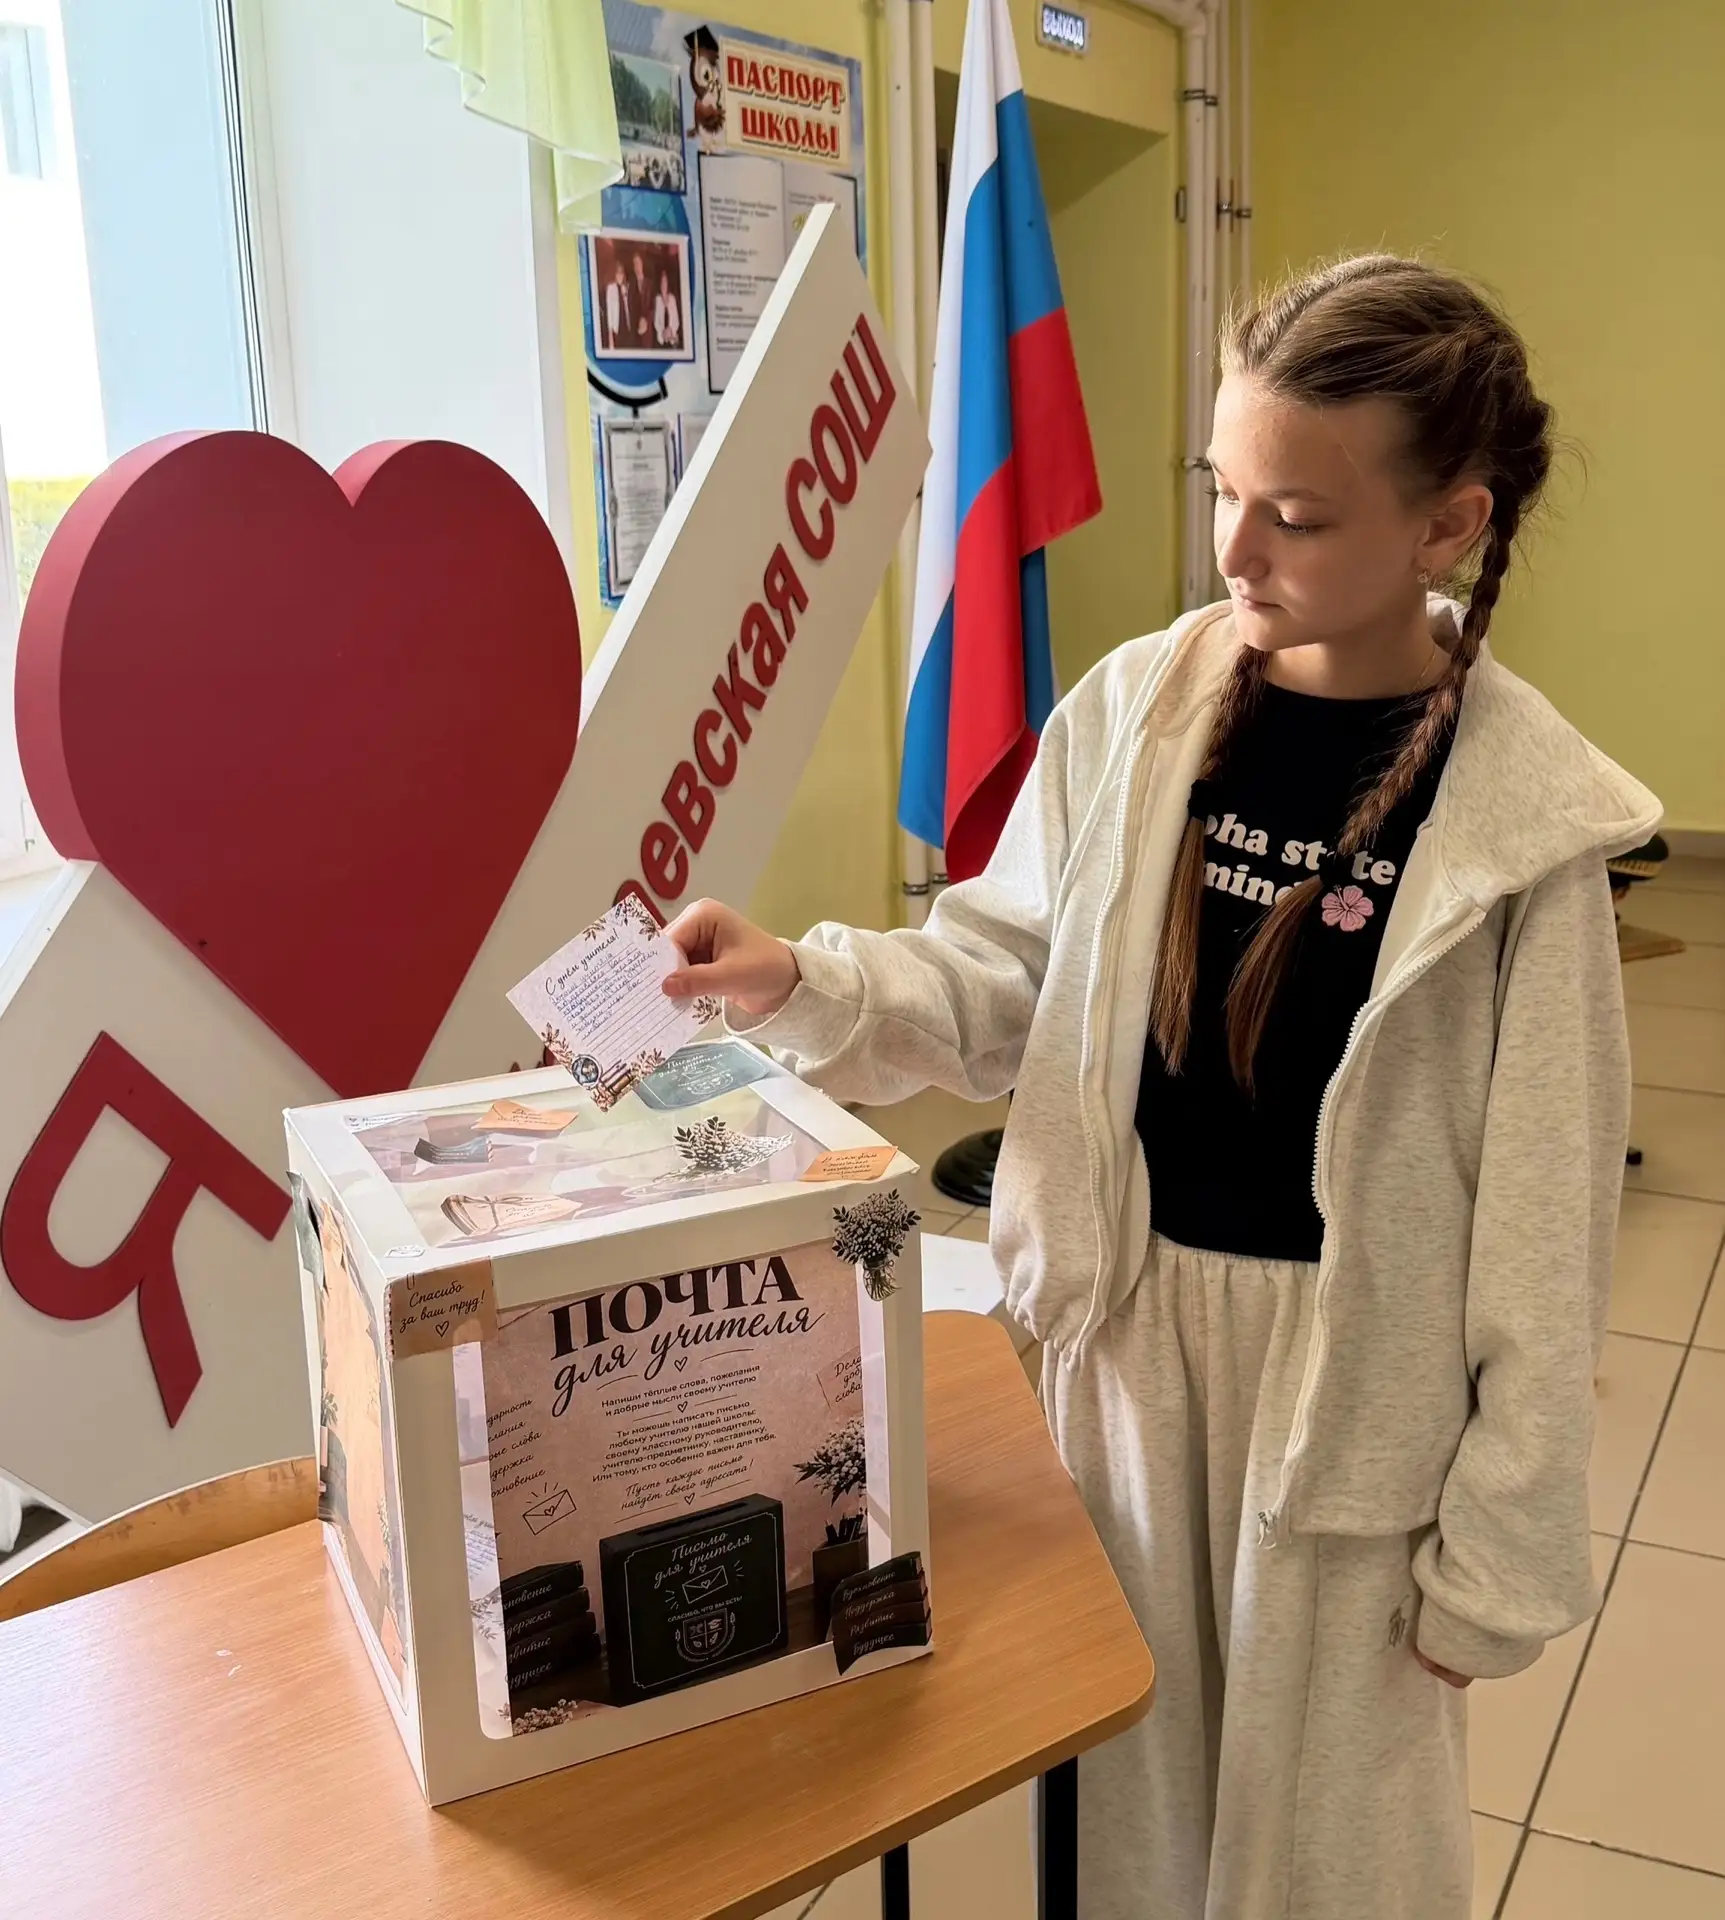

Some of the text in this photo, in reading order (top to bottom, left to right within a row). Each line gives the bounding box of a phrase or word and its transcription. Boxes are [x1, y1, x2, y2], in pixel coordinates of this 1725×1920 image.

[726, 55, 846, 113] ПАСПОРТ
[740, 106, 841, 158] ШКОЛЫ
[786, 313, 897, 562] СОШ
[1281, 840, 1396, 886] stte
[545, 976, 556, 996] С
[580, 927, 620, 971] учителя!
[0, 1030, 294, 1430] Я
[399, 1289, 486, 1334] за ваш труд!
[409, 1280, 465, 1308] Спасибо
[548, 1256, 804, 1361] ПОЧТА
[551, 1307, 826, 1418] для учителя
[601, 1365, 760, 1408] Напиши тёплые слова, пожелания
[613, 1401, 650, 1415] добрые
[652, 1394, 682, 1406] мысли
[684, 1385, 717, 1398] своему
[718, 1375, 757, 1391] учителю
[835, 1381, 863, 1403] слова
[511, 1431, 543, 1450] слова
[605, 1418, 762, 1460] своему классному руководителю,
[608, 1409, 757, 1450] любому учителю нашей школы:
[616, 1401, 750, 1438] Ты можешь написать письмо
[592, 1433, 777, 1482] Или тому, кто особенно важен для тебя.
[602, 1426, 767, 1472] учителю-предметнику, наставнику,
[621, 1458, 754, 1510] найдёт своего адресата!
[626, 1454, 743, 1497] Пусть каждое письмо
[654, 1534, 753, 1589] для учителя
[672, 1532, 728, 1561] Письмо
